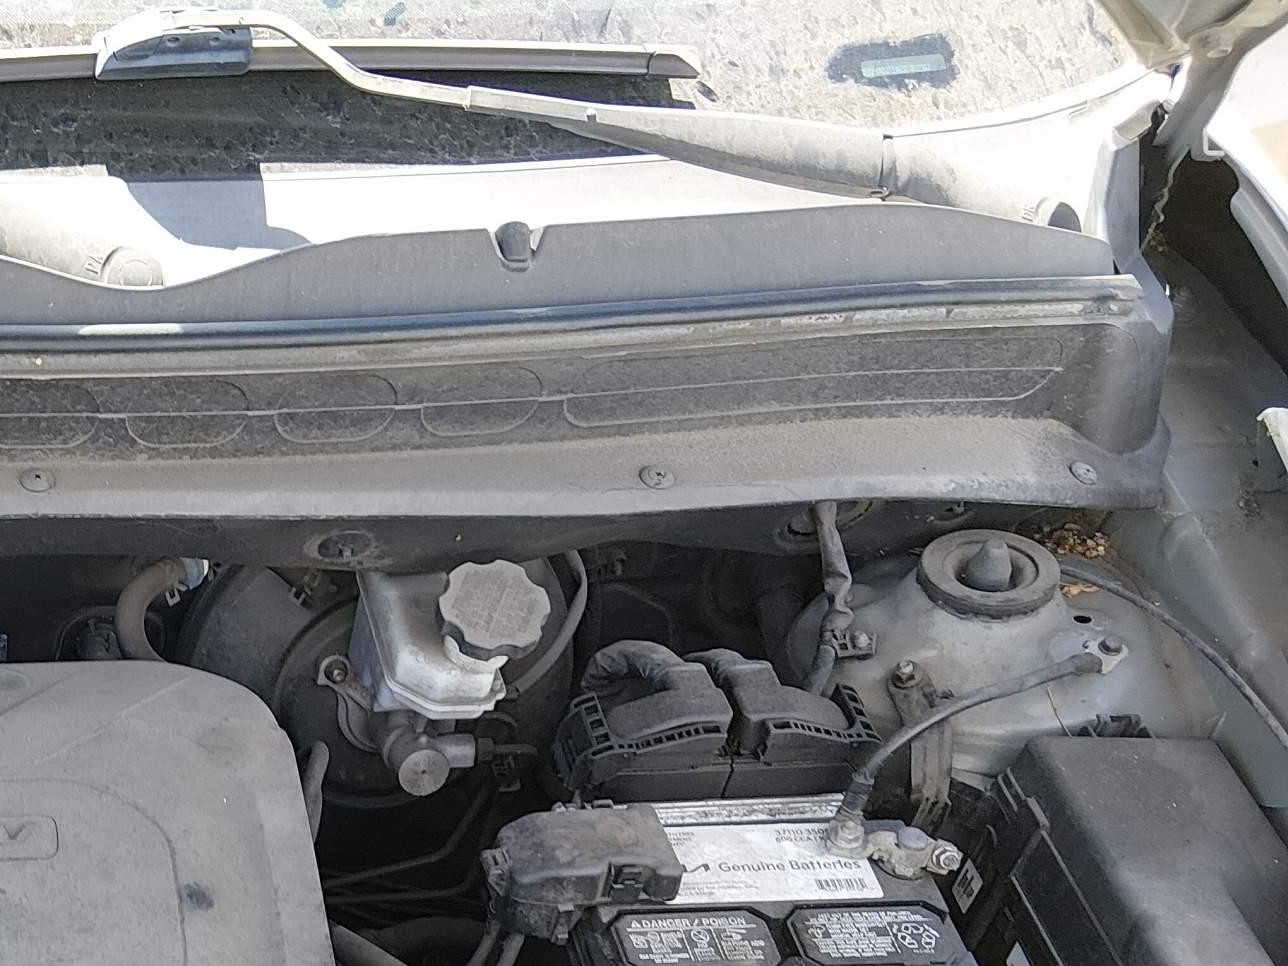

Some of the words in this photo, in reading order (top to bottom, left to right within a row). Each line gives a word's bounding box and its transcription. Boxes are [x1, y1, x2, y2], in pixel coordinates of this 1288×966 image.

[718, 860, 786, 874] Genuine
[788, 859, 861, 872] Batteries
[641, 918, 691, 929] DANGER
[701, 916, 746, 927] POISON
